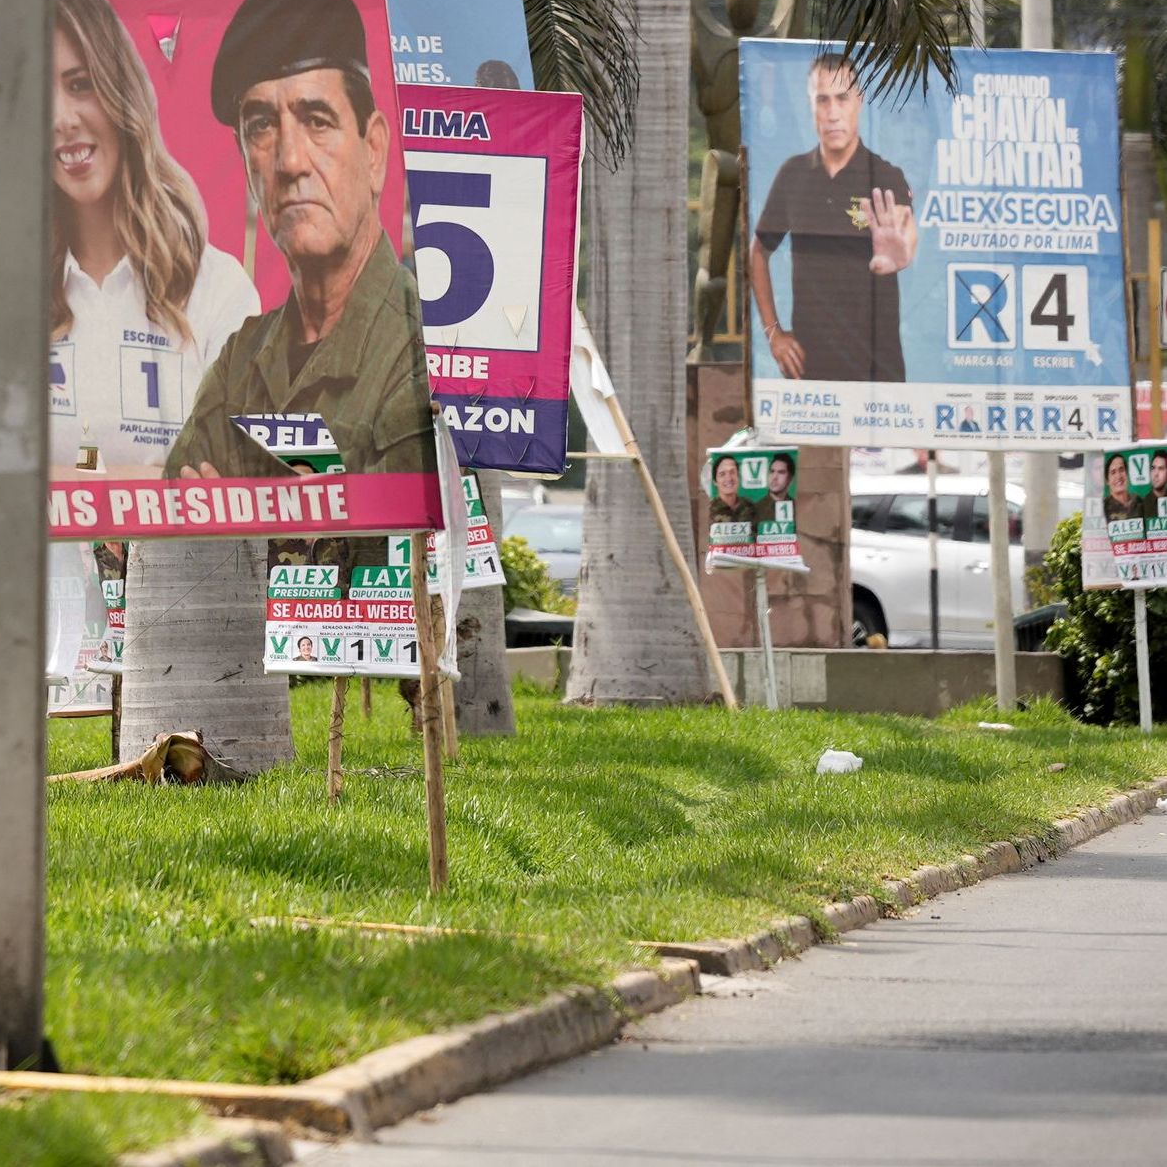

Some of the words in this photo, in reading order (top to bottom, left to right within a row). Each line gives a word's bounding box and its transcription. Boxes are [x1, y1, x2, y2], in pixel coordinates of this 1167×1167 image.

[416, 35, 443, 53] DE
[973, 73, 1050, 98] COMANDO
[403, 108, 491, 140] LIMA
[924, 195, 997, 225] ALEX
[1001, 197, 1114, 227] SEGURA
[944, 232, 1019, 248] DIPUTADO
[1024, 234, 1053, 249] POR
[1057, 235, 1094, 250] LIMA
[955, 270, 1010, 343] R
[1030, 273, 1076, 342] 4
[141, 361, 160, 409] 1
[760, 400, 773, 417] R
[783, 392, 841, 407] RAFAEL
[864, 402, 889, 413] VOTA
[894, 416, 914, 429] LAS
[1067, 408, 1083, 432] 4
[133, 434, 170, 446] ANDINO
[747, 461, 762, 479] V
[462, 478, 473, 499] 1
[109, 483, 349, 526] PRESIDENTE
[780, 502, 789, 521] 1
[714, 523, 747, 534] ALEX
[763, 523, 790, 534] LAY
[1112, 520, 1142, 534] ALEX
[484, 555, 497, 574] 1
[273, 568, 335, 585] ALEX
[362, 568, 411, 586] LAY
[273, 588, 335, 598] PRESIDENTE
[351, 589, 397, 599] DIPUTADO
[272, 602, 291, 619] SE
[293, 600, 343, 619] ACABÓ
[346, 602, 364, 619] EL
[269, 636, 289, 654] V
[322, 637, 341, 657] V
[350, 639, 364, 661] 1
[374, 638, 394, 658] V
[403, 640, 417, 663] 1
